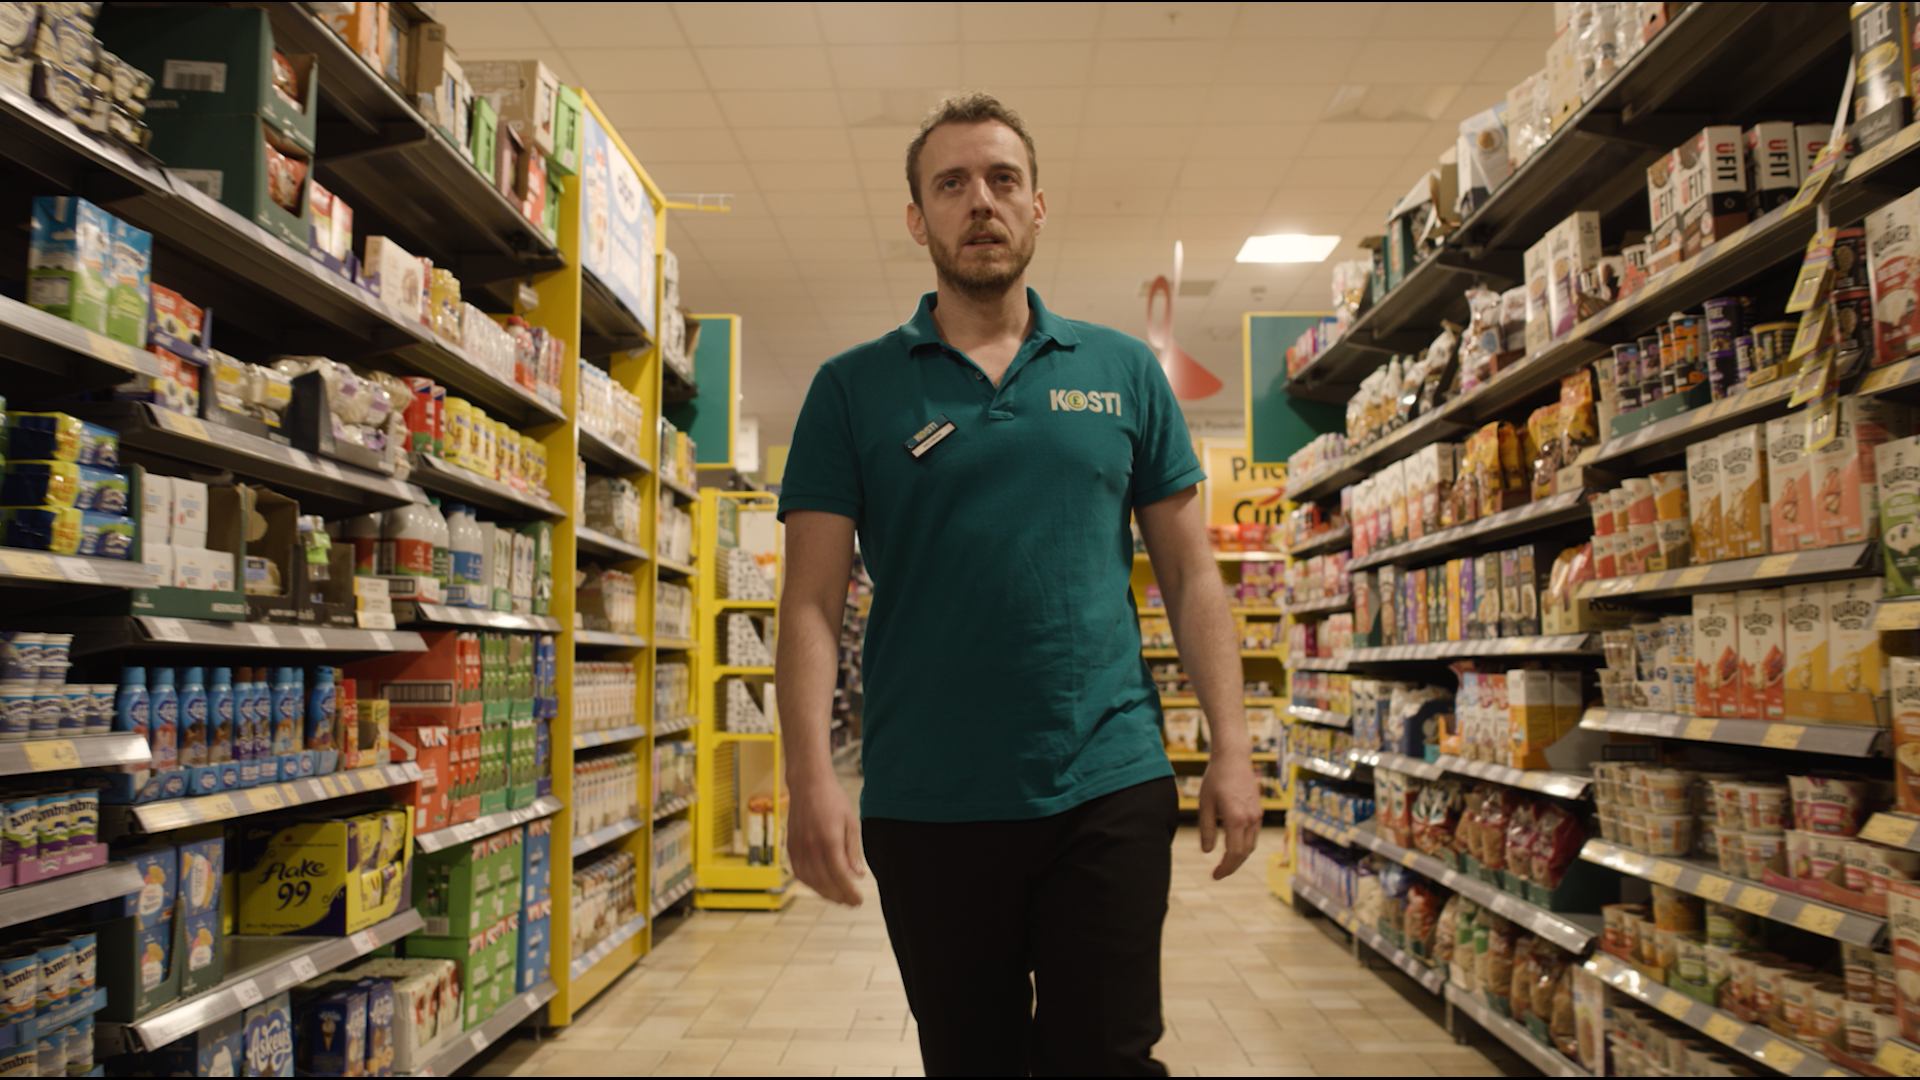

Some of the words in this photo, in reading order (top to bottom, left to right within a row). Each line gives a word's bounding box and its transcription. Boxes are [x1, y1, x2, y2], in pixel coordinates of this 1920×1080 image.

[1050, 389, 1122, 416] KOSTI
[1232, 456, 1288, 481] Pric
[277, 880, 312, 912] 99
